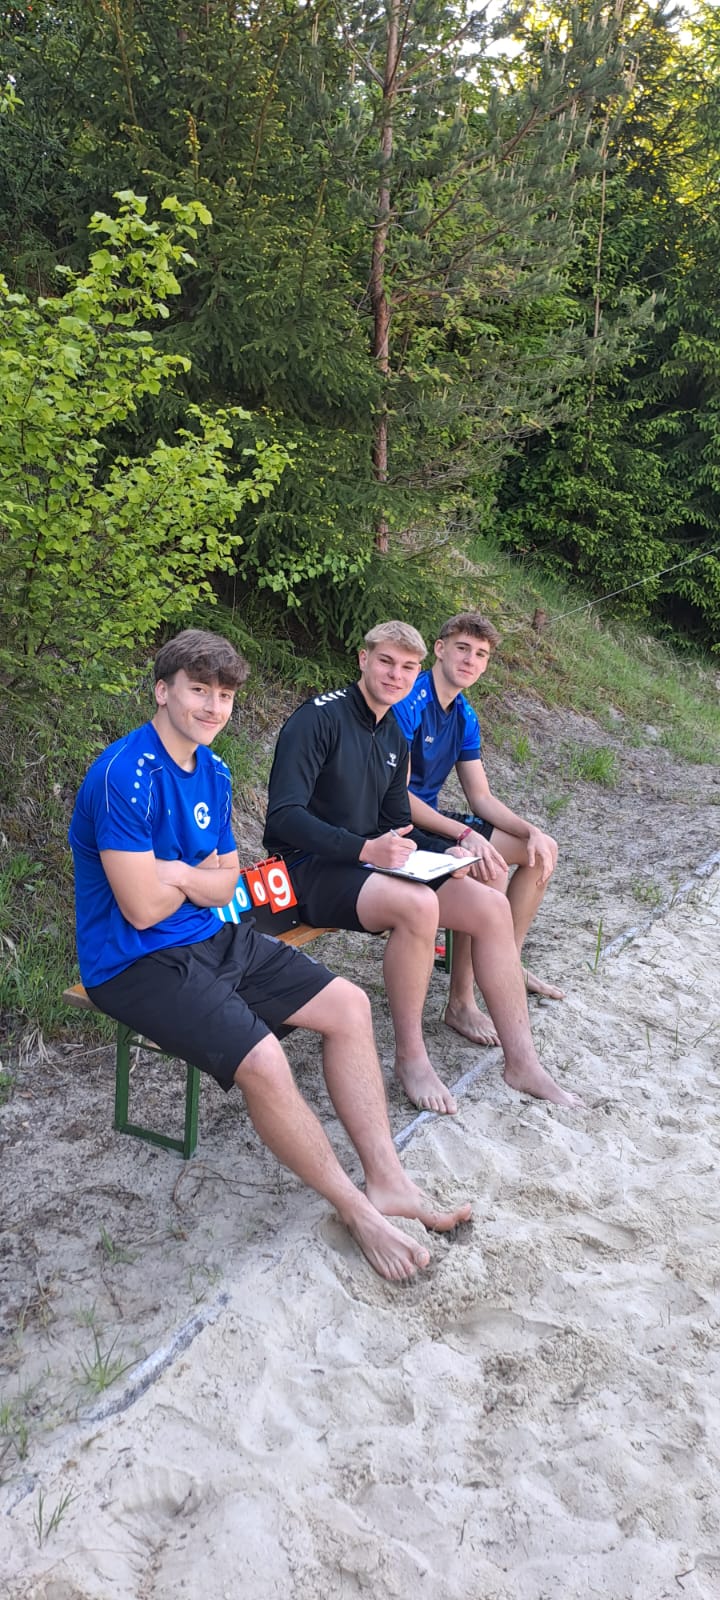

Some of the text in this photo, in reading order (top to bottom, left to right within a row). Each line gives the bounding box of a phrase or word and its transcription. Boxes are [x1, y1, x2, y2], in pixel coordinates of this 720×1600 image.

[235, 868, 291, 908] 0 0 9
